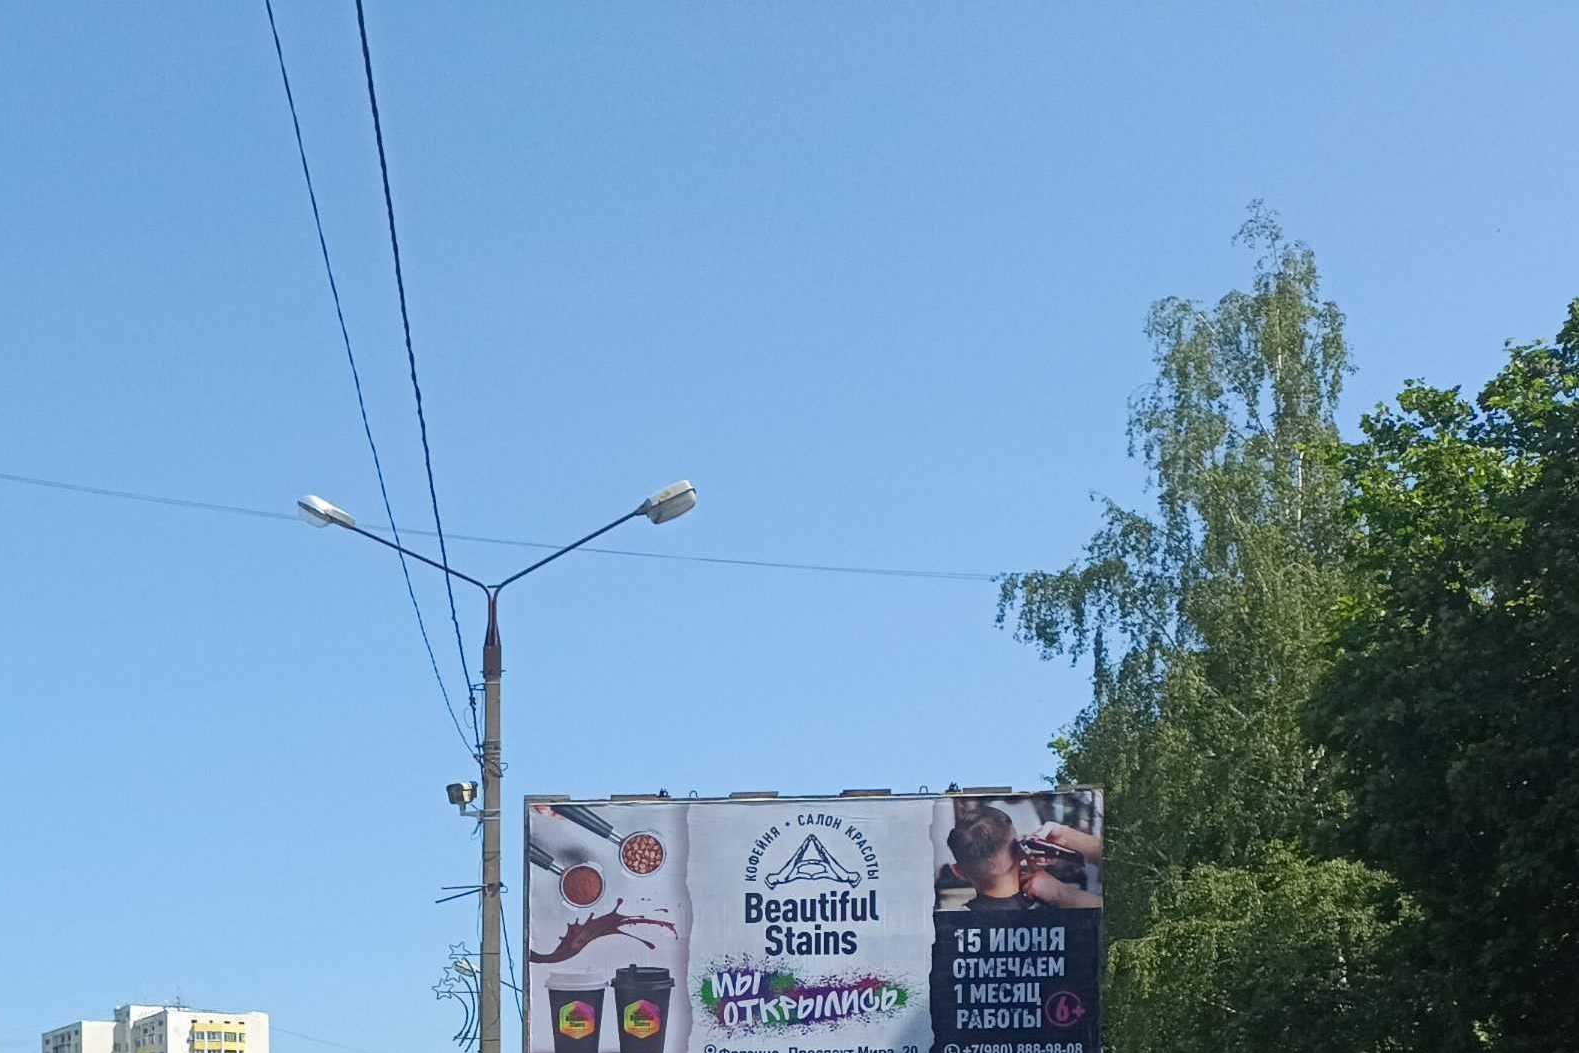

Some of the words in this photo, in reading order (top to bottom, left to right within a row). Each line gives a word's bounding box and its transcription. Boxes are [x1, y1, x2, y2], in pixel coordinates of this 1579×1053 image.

[744, 826, 781, 882] КОФЕЙНЯ
[797, 813, 843, 830] САЛОН
[845, 825, 880, 880] КРАСОТЫ
[744, 890, 880, 924] Beautiful
[764, 924, 858, 957] Stains
[954, 928, 982, 953] 15
[989, 926, 1066, 953] ИЮНЯ
[952, 956, 1065, 979] ОТМЕЧАЕМ
[711, 972, 762, 998] МЫ
[954, 983, 963, 1004] 1
[970, 982, 1042, 1006] МЕСЯЦ
[723, 986, 898, 1026] ОТКРЫЛИСЬ
[956, 1008, 1042, 1030] РАБОТЫ
[1055, 995, 1087, 1022] 6+
